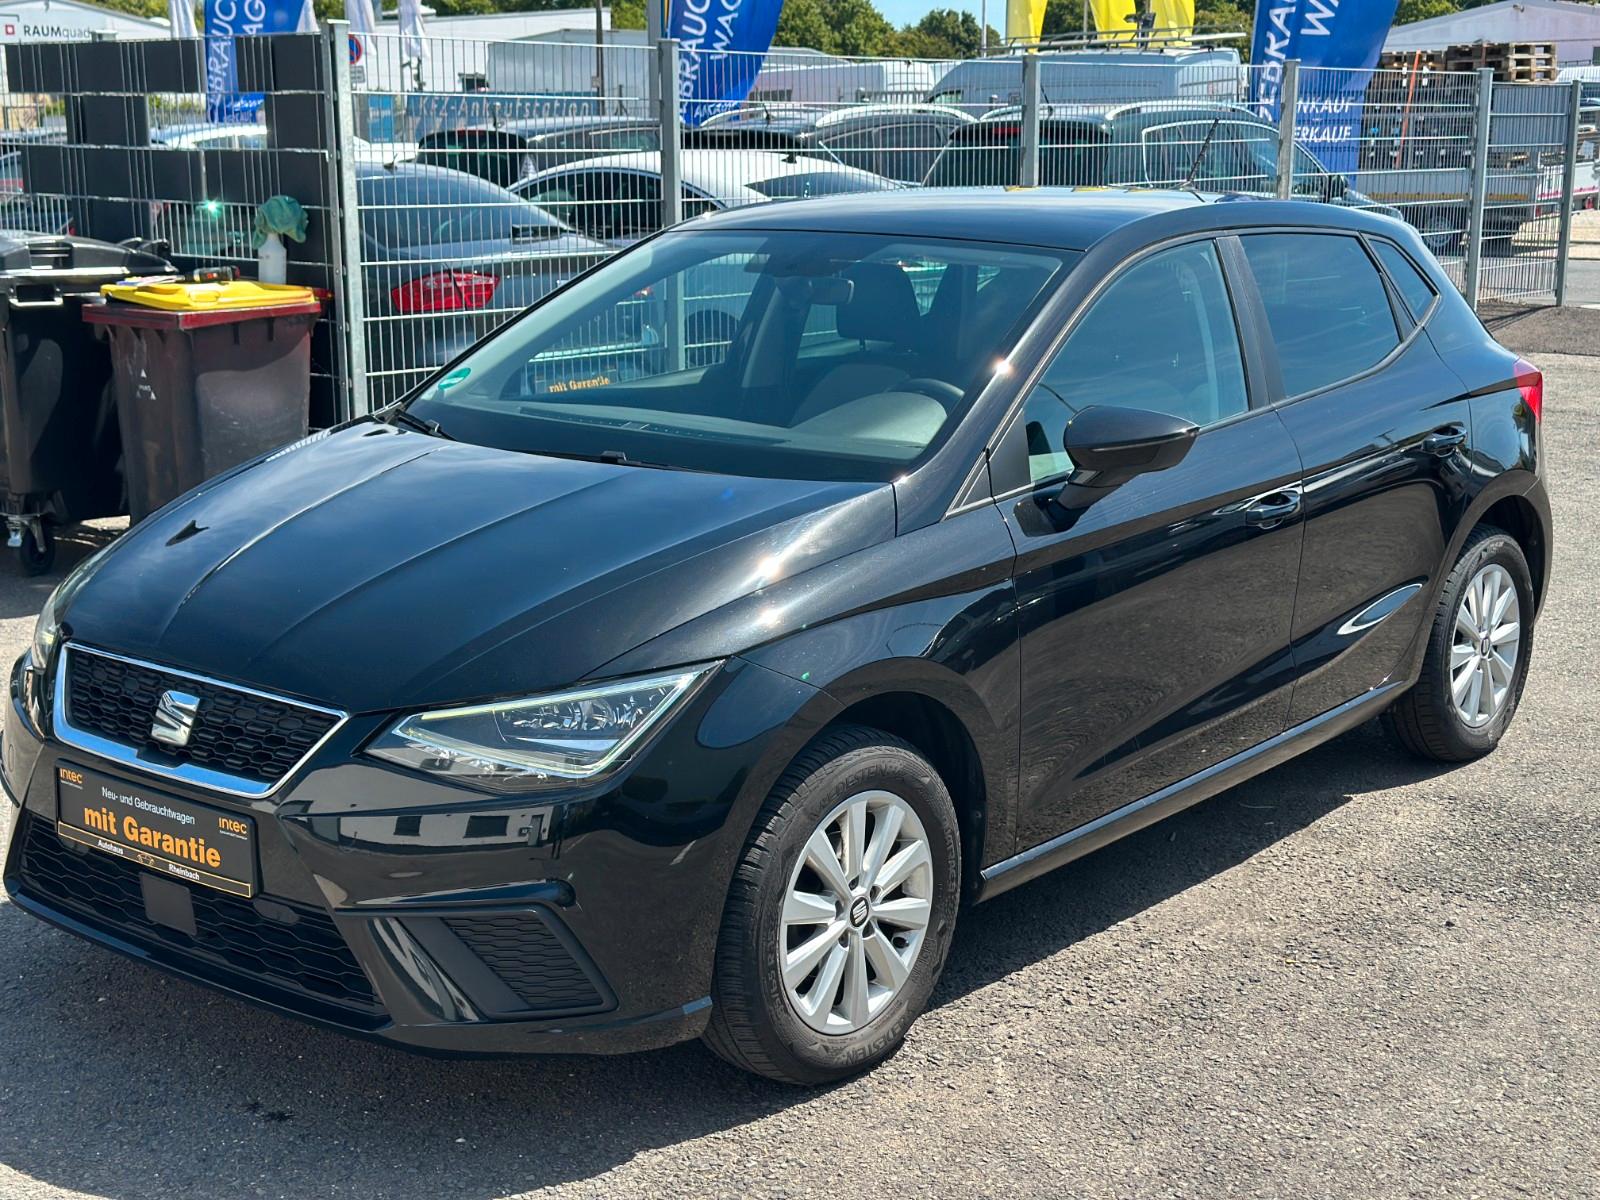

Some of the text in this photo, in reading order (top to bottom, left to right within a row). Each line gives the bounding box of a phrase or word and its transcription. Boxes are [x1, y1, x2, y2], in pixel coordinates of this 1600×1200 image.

[101, 786, 196, 825] Neu- und Gebrauchtwagen
[218, 817, 247, 834] intec
[84, 807, 221, 868] mit Garantie
[97, 839, 200, 881] Autohaus Rheinbach
